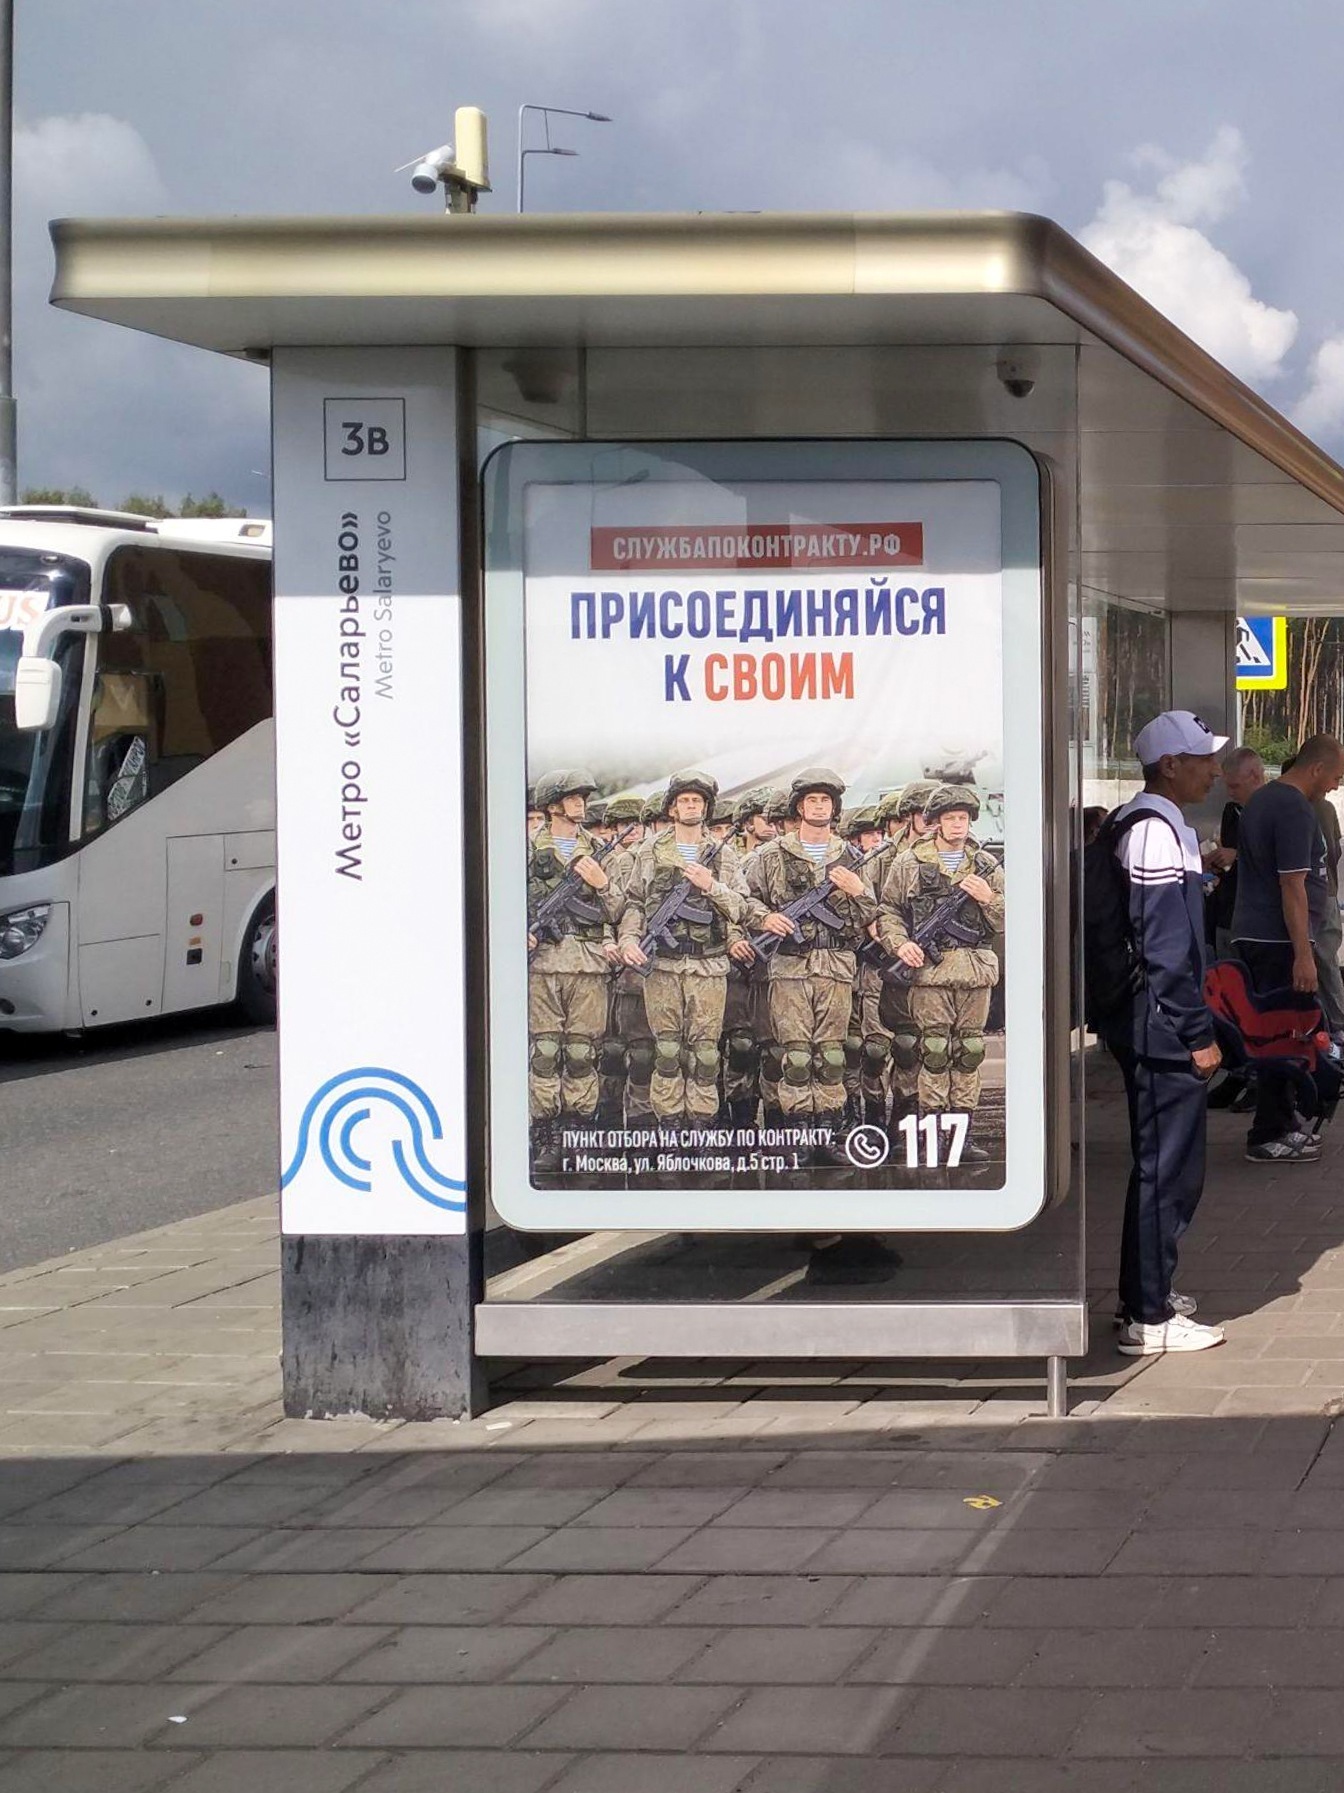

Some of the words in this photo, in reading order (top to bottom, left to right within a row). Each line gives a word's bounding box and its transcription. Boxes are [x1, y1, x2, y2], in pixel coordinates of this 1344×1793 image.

[373, 511, 397, 622] Salaryevo
[613, 533, 901, 560] СЛУЖБАПОКОНТРАКТУ.РФ
[333, 511, 366, 747] «Саларьево»
[571, 577, 946, 642] ПРИСОЕДИНЯЙСЯ
[375, 629, 394, 700] Metro
[665, 654, 691, 701] К
[704, 652, 854, 701] СВОИМ
[335, 760, 369, 881] Метро
[563, 1130, 604, 1148] ПУНКТ
[608, 1130, 657, 1148] ОТБОРА
[660, 1130, 678, 1148] НА
[681, 1129, 733, 1148] СЛУЖБУ
[737, 1129, 755, 1147] ПО
[759, 1128, 836, 1147] КОНТРАКТУ:
[576, 1156, 632, 1173] Москва,
[634, 1157, 654, 1174] ул.
[657, 1153, 735, 1172] Яблочкова,
[762, 1156, 789, 1174] стр.
[793, 1153, 800, 1169] 1
[899, 1114, 970, 1168] 117
